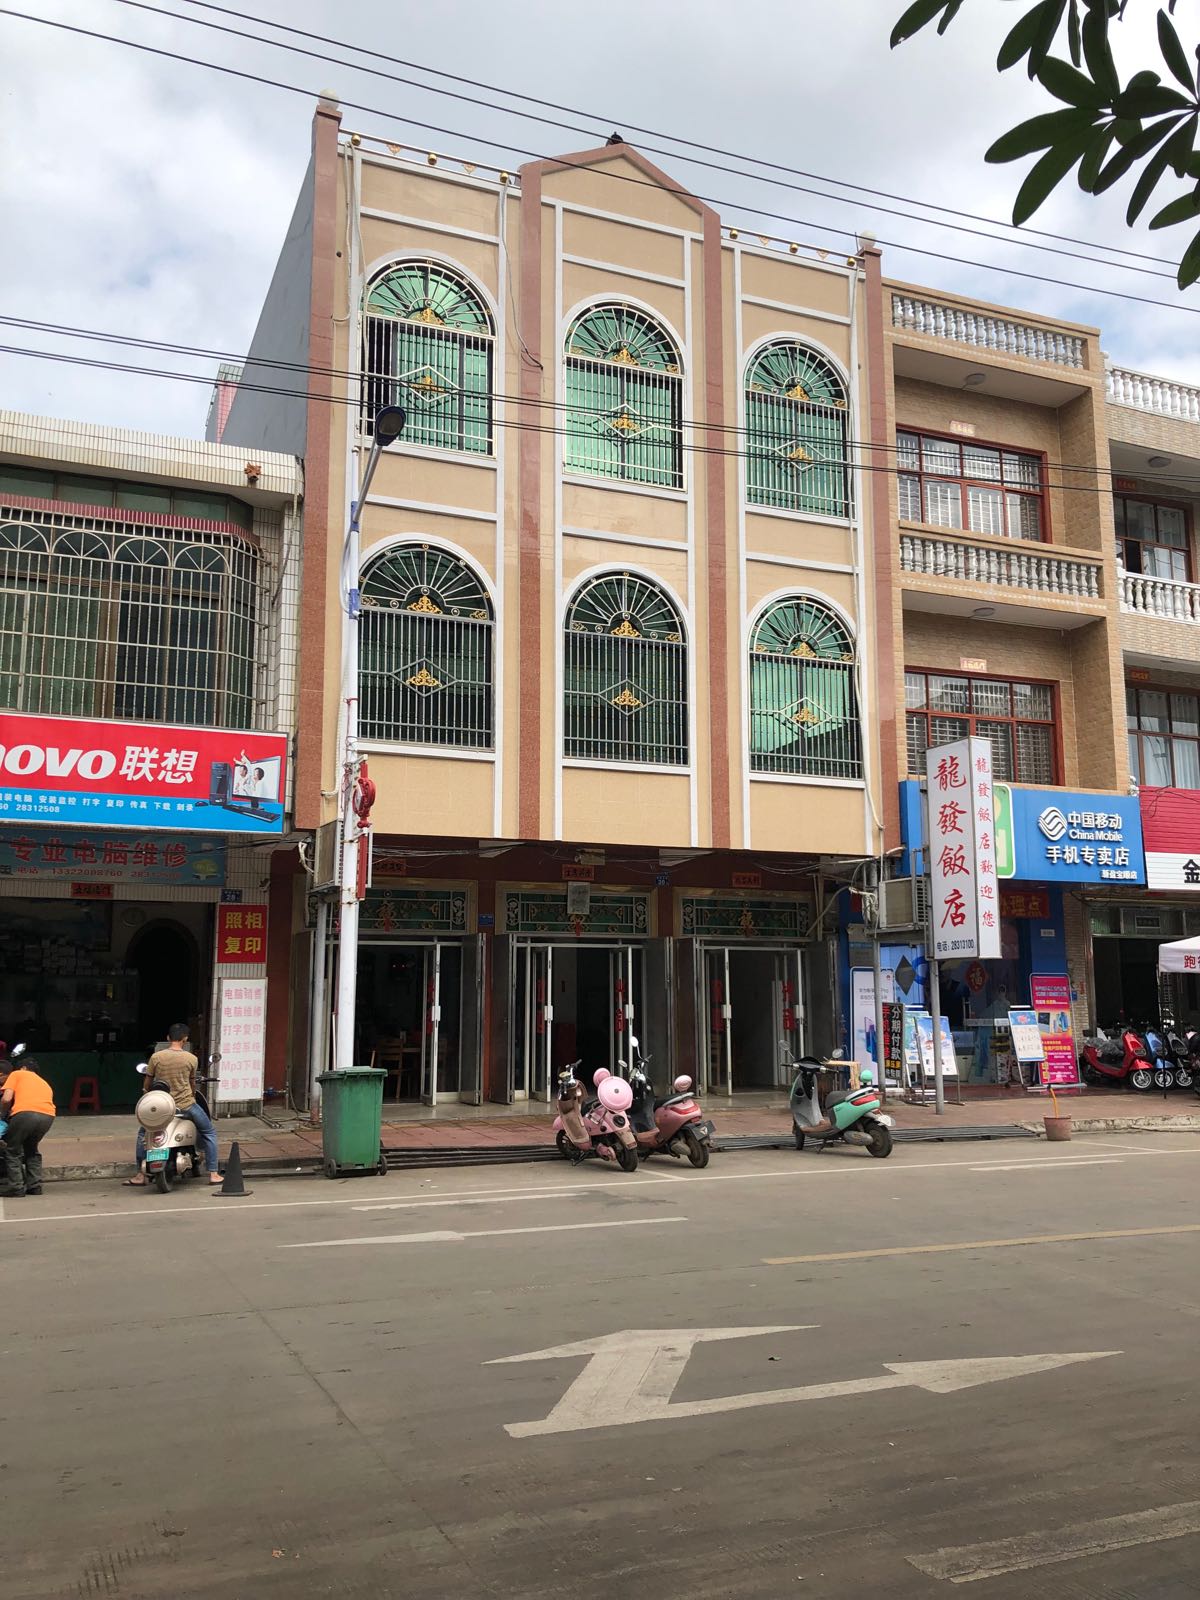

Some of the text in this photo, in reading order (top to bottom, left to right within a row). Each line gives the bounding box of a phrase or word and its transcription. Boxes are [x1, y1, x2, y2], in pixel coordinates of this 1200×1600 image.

[0, 744, 117, 780] ovo
[119, 745, 199, 784] 联想
[16, 804, 60, 813] 28312508
[82, 798, 100, 807] 打字
[1067, 811, 1122, 829] 中国移动
[933, 755, 970, 929] 龍發飯店
[1069, 829, 1123, 841] China Mobile
[9, 836, 188, 867] 专业电脑维修
[1046, 846, 1130, 865] 手机专卖店
[225, 911, 263, 929] 照相
[225, 937, 262, 954] 复印
[223, 1023, 261, 1036] 打字复印
[891, 1005, 902, 1060] 分期付款
